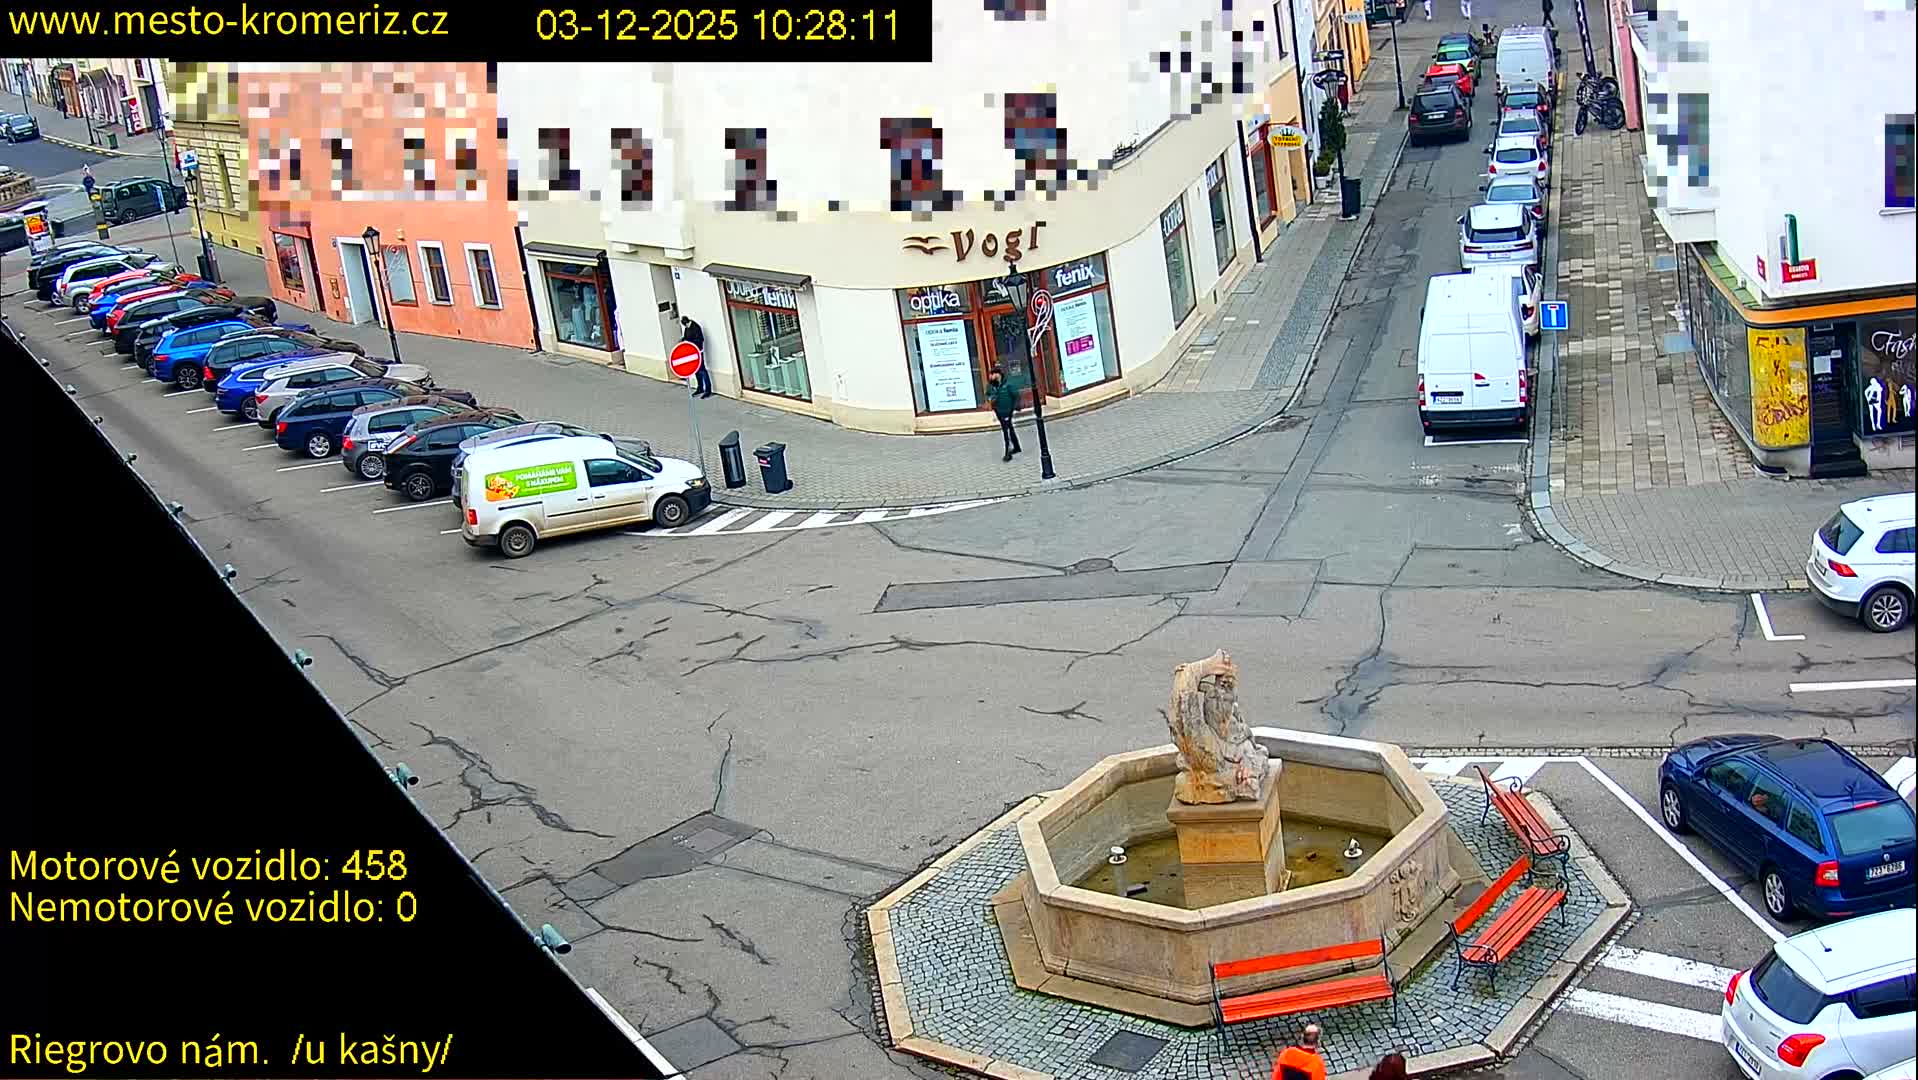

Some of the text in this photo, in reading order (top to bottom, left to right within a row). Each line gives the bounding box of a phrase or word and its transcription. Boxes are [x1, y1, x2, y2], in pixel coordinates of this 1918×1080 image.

[130, 105, 141, 131] DEK
[1055, 263, 1095, 288] fenix
[910, 289, 961, 315] optika
